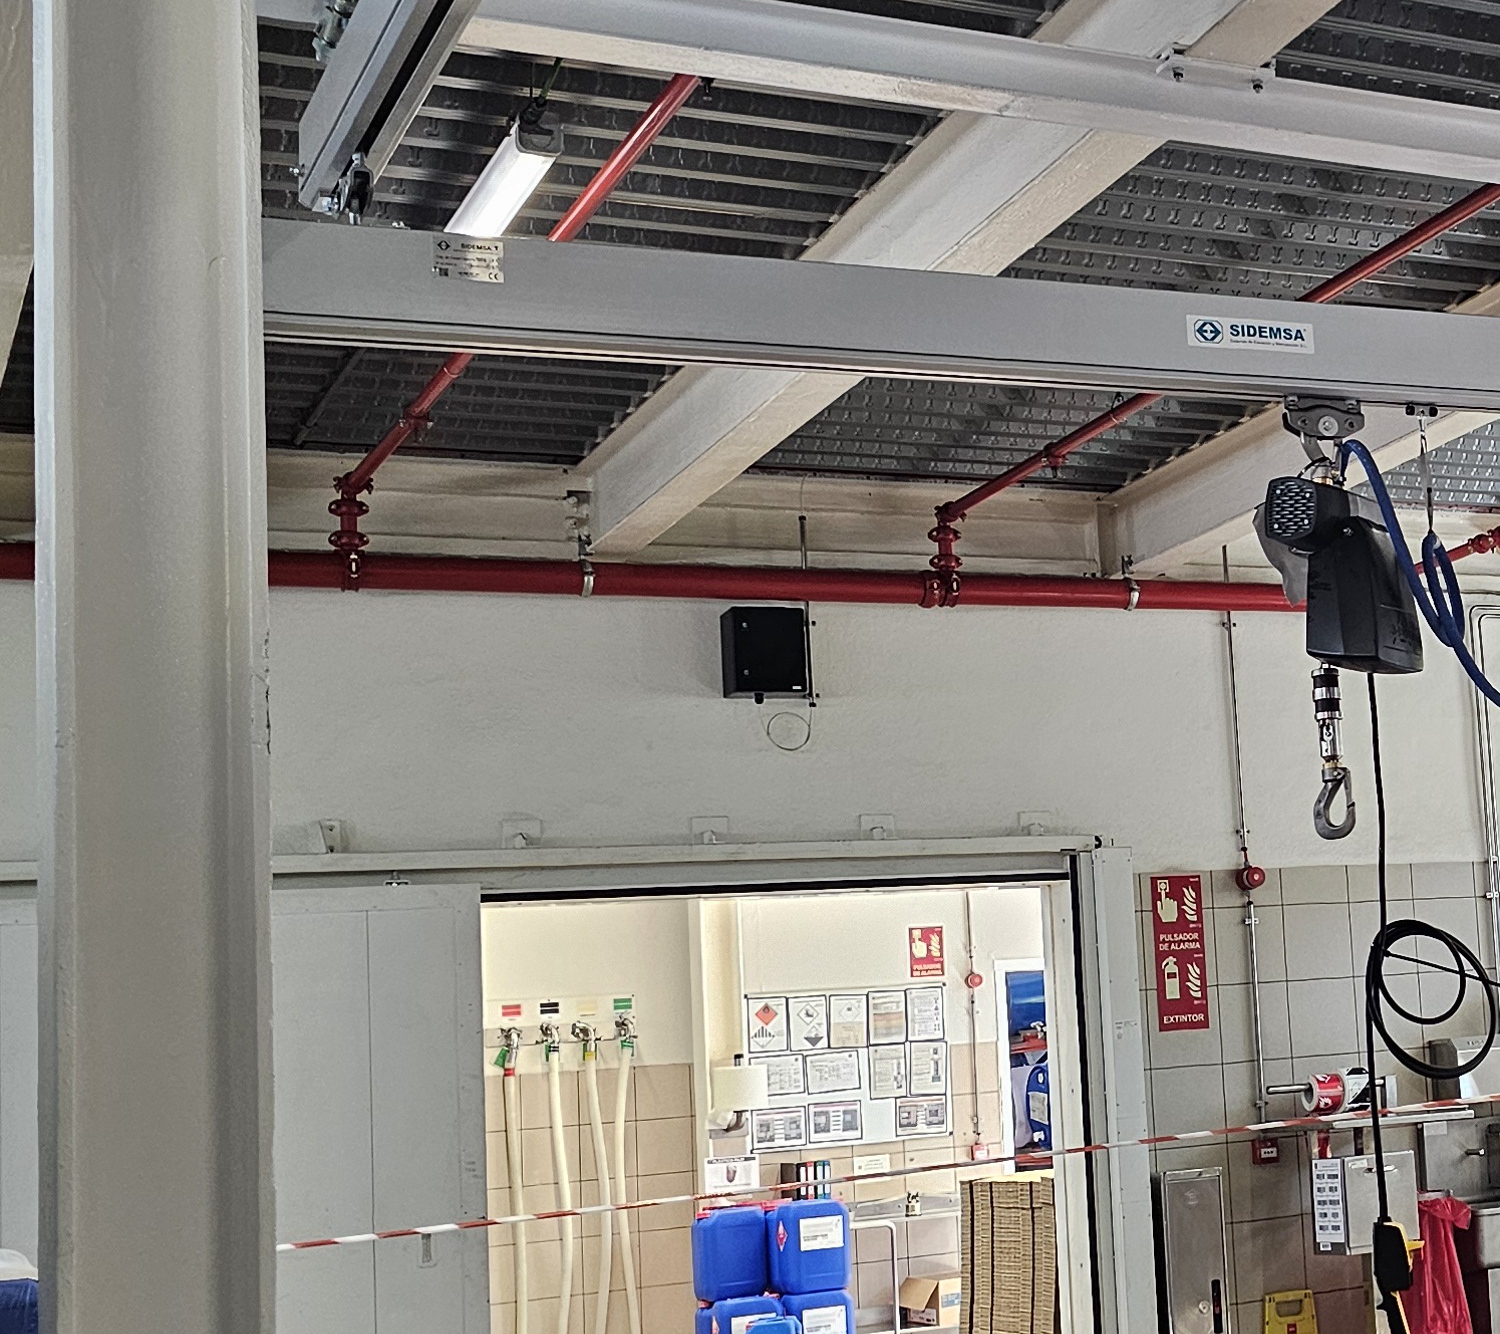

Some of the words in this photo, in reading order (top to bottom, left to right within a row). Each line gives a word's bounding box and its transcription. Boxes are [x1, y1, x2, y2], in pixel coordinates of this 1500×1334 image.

[1229, 324, 1305, 342] SIDEMSA
[1159, 932, 1199, 942] PULSADOR
[1159, 942, 1169, 951] DE
[1170, 941, 1201, 950] ALARMA
[1163, 1013, 1205, 1024] EXTINTOR
